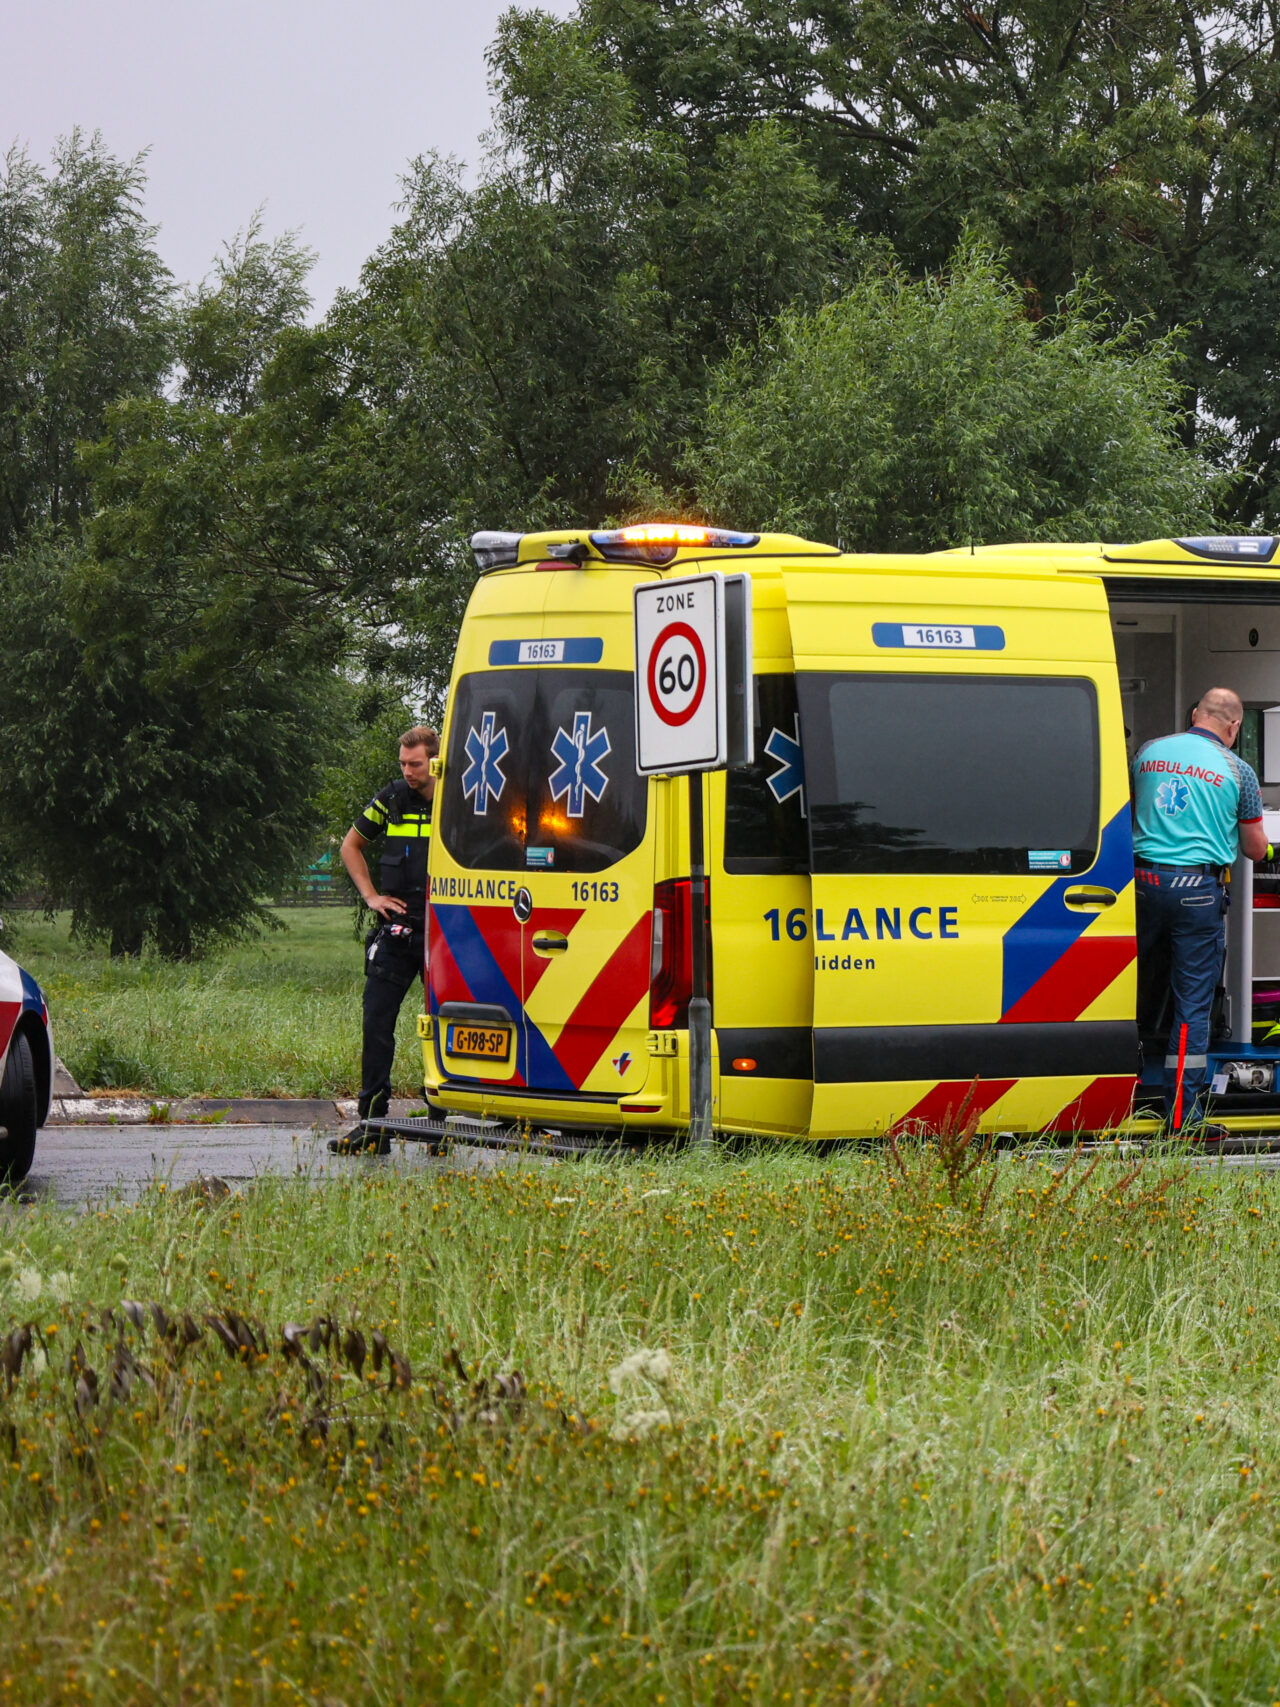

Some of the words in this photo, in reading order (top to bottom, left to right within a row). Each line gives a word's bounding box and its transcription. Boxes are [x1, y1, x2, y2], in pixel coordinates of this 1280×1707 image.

[656, 591, 695, 614] ZONE
[914, 628, 963, 644] 16163
[527, 643, 557, 660] 16163
[658, 653, 696, 695] 60
[1139, 759, 1225, 788] AMBULANCE
[430, 876, 517, 901] AMBULANCE
[571, 881, 620, 903] 16163
[763, 907, 808, 942] 16
[815, 906, 960, 941] LANCE
[814, 954, 876, 971] idden
[456, 1029, 504, 1054] G-198-SP
